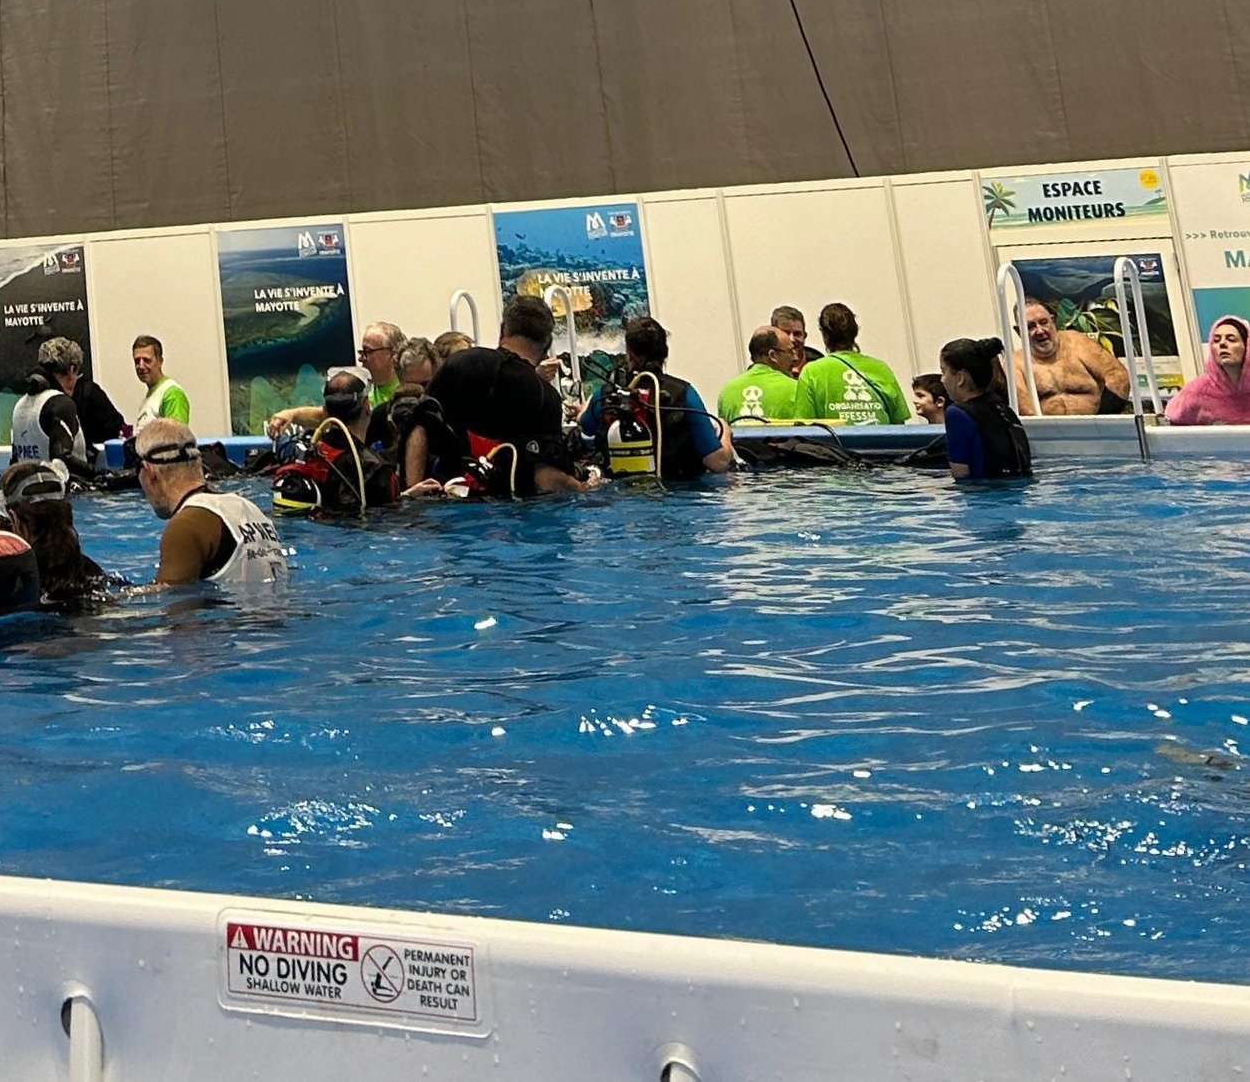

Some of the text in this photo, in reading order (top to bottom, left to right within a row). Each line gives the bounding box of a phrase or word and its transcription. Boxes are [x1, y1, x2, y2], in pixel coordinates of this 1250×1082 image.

[1042, 180, 1103, 198] ESPACE
[1027, 202, 1126, 223] MONITEURS
[538, 266, 640, 284] LA VIE S'INVENTE À
[254, 283, 345, 299] LA VIE S'INVENTE À
[4, 299, 84, 314] LA VIE S'INVENTE À
[255, 301, 300, 312] MAYOTTE
[5, 315, 44, 327] MAYOTTE
[839, 411, 877, 421] FFESSM
[252, 927, 354, 960] WARNING
[404, 948, 470, 967] PERMANENT
[238, 953, 348, 986] NO DIVING
[408, 964, 467, 982] INJURY OR
[246, 976, 342, 999] SHALLOW WATER
[407, 978, 470, 997] DEATH CAN
[420, 995, 458, 1010] RESULT
